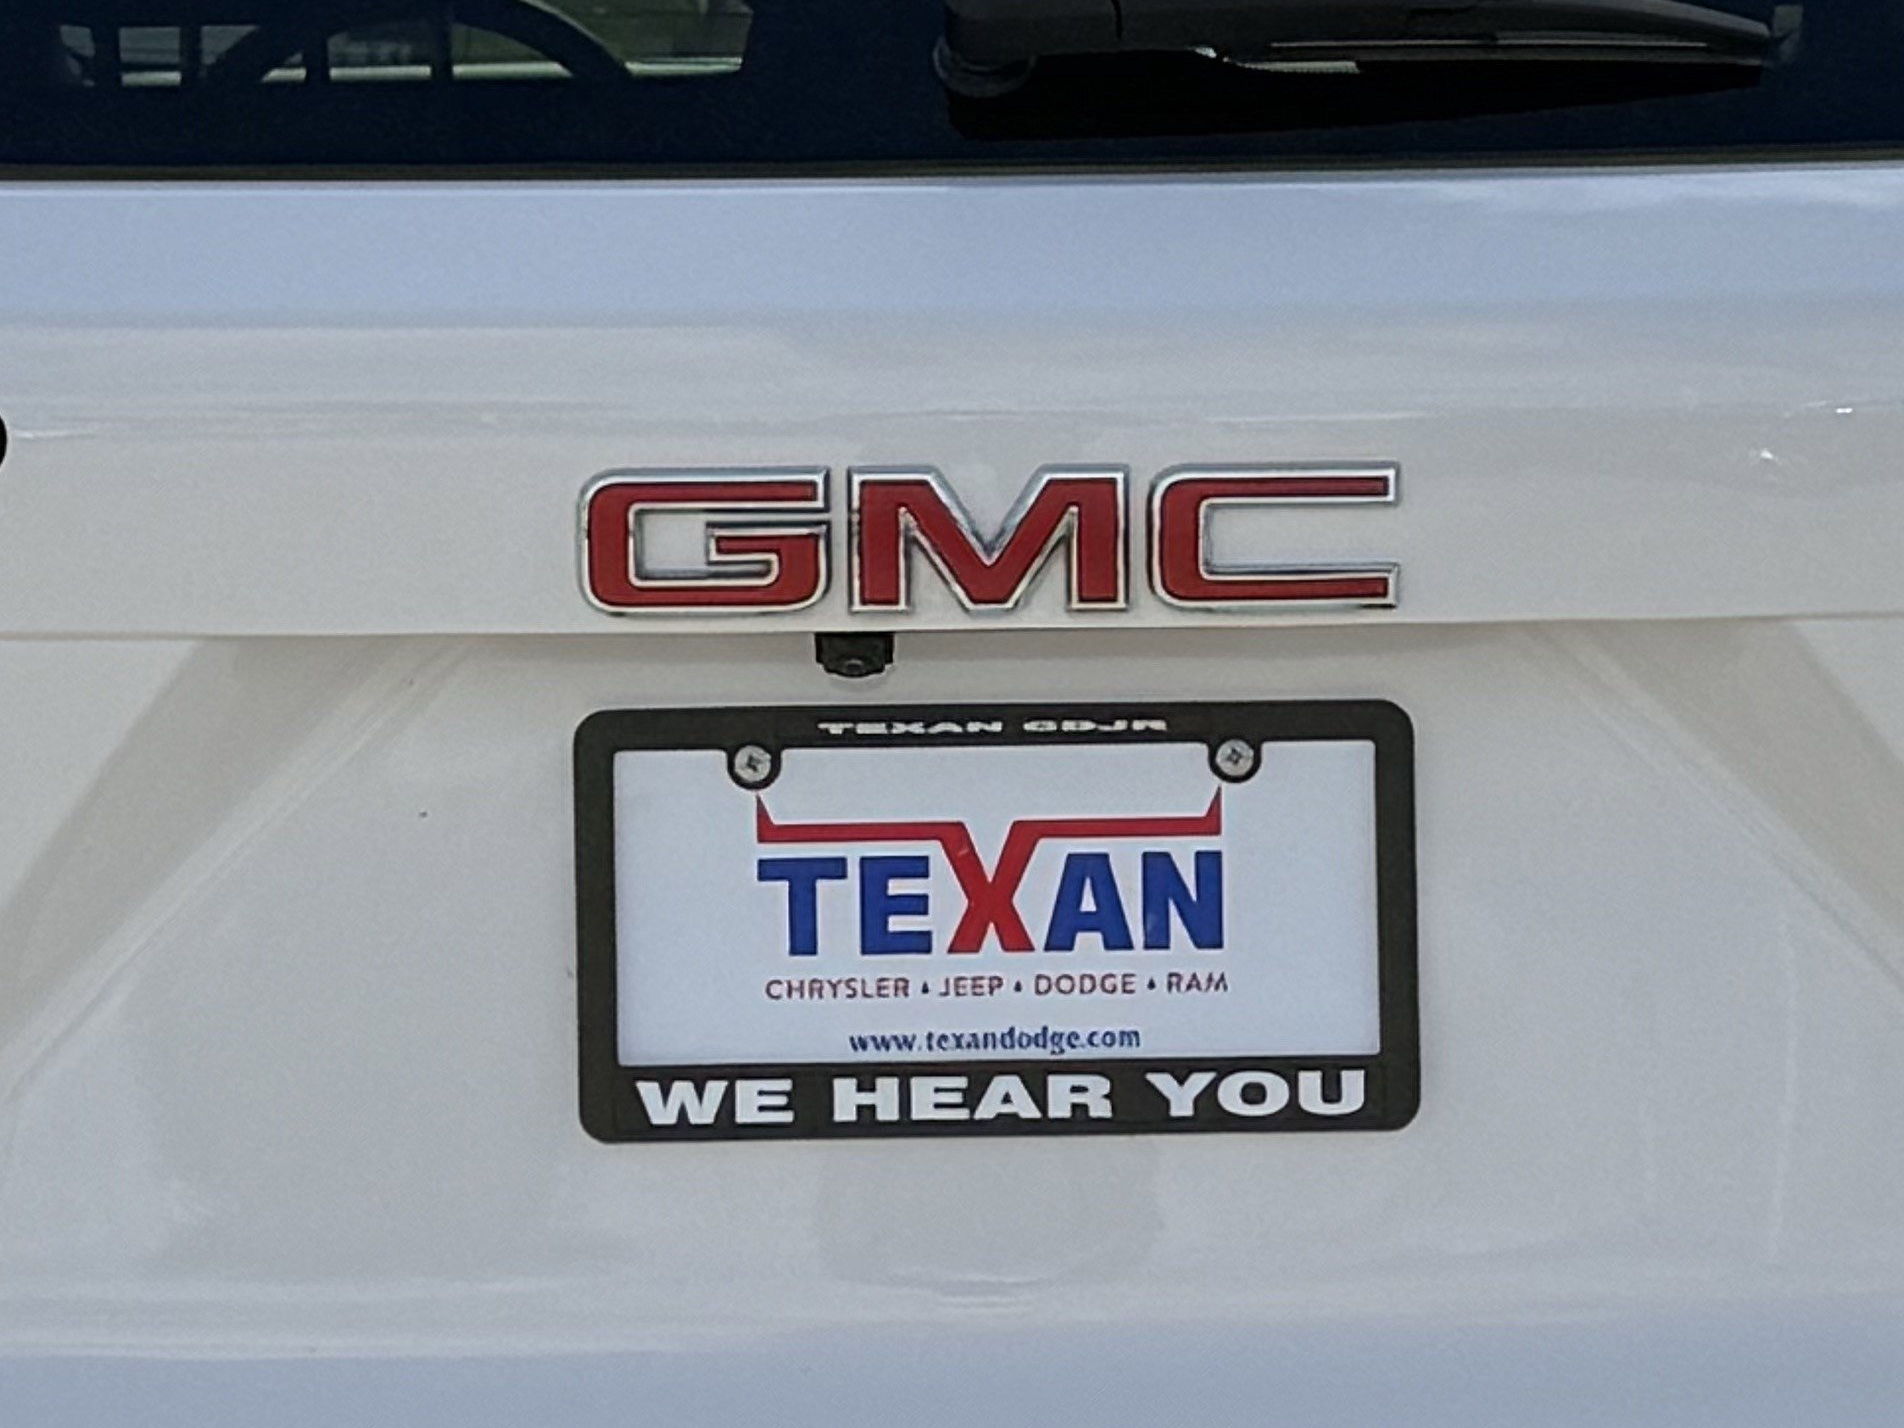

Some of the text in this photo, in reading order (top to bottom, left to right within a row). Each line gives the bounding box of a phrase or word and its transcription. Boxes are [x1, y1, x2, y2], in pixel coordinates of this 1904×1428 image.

[580, 463, 1402, 614] GMC
[817, 721, 1003, 736] TEXAN
[756, 786, 1225, 957] TEXAN
[765, 971, 1230, 1001] CHRYSLER JEEP DODGE RAM
[848, 1026, 1142, 1056] www.texandodge.com
[636, 1071, 1366, 1125] WE HEAR YOU
